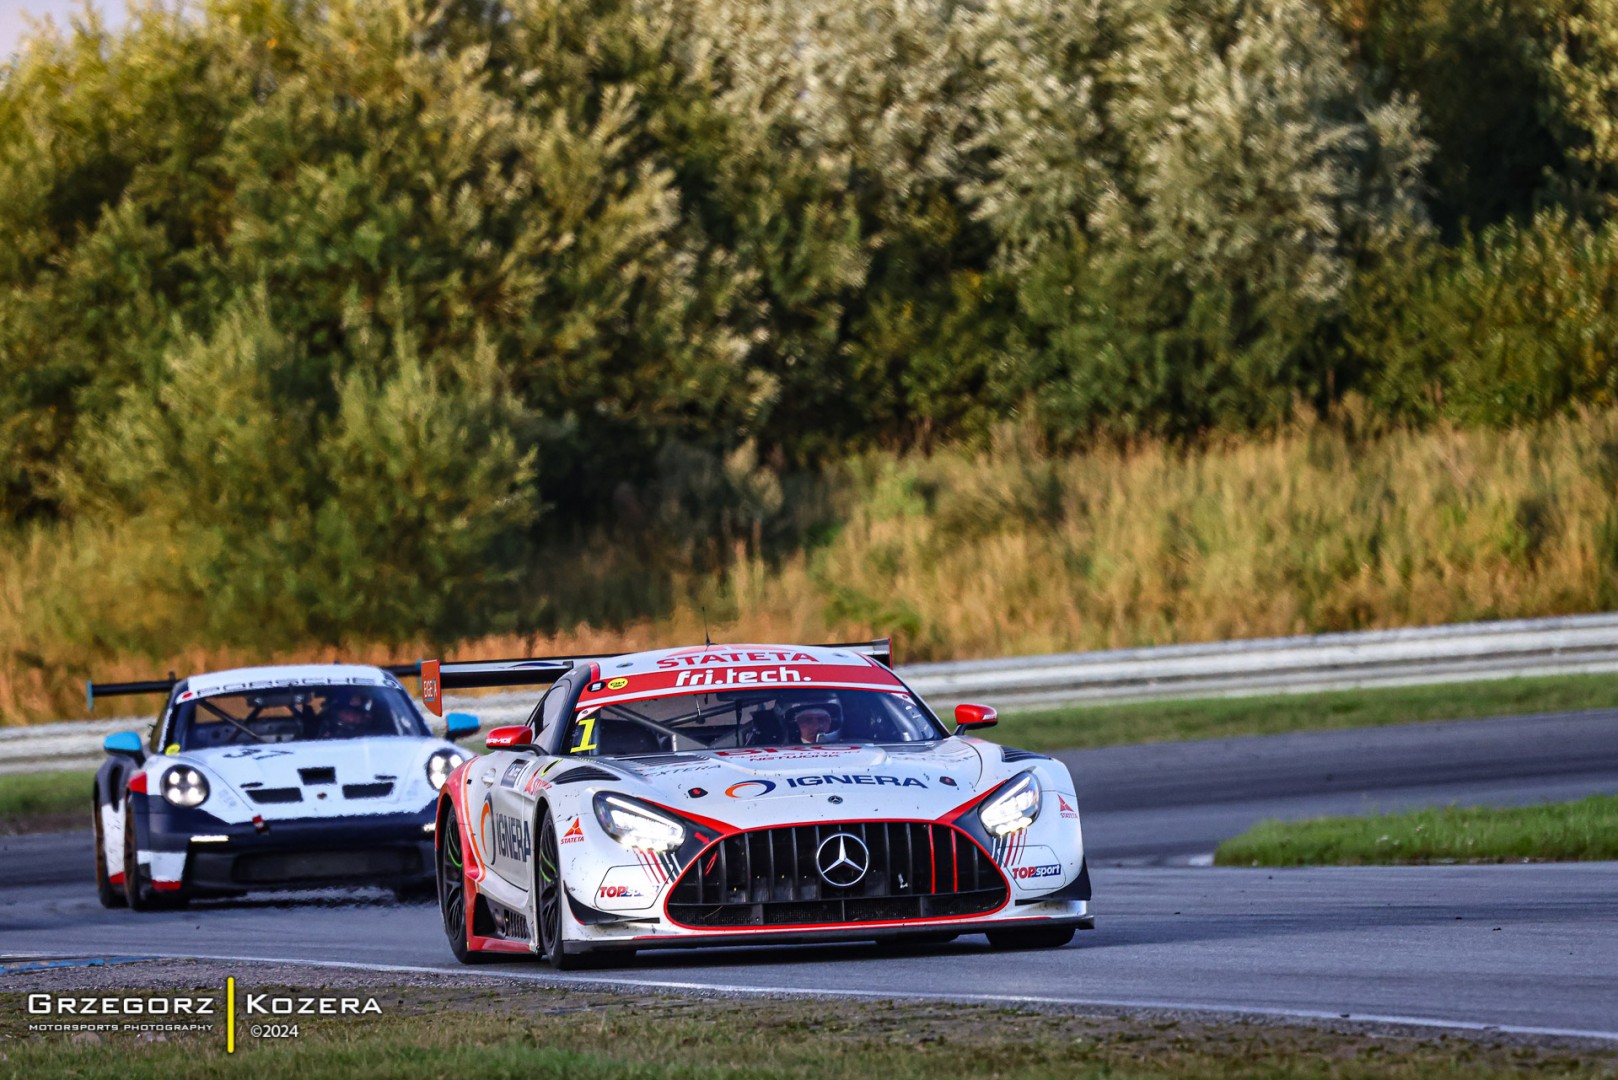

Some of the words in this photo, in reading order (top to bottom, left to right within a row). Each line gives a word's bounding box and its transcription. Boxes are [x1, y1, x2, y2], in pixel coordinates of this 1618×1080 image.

[656, 652, 820, 669] STATETA
[675, 666, 812, 687] fri.tech.
[569, 718, 597, 754] 1
[786, 774, 929, 789] IGNERA
[496, 812, 531, 863] IGNERA
[560, 835, 585, 845] STATETA
[1011, 864, 1060, 880] TOPsport
